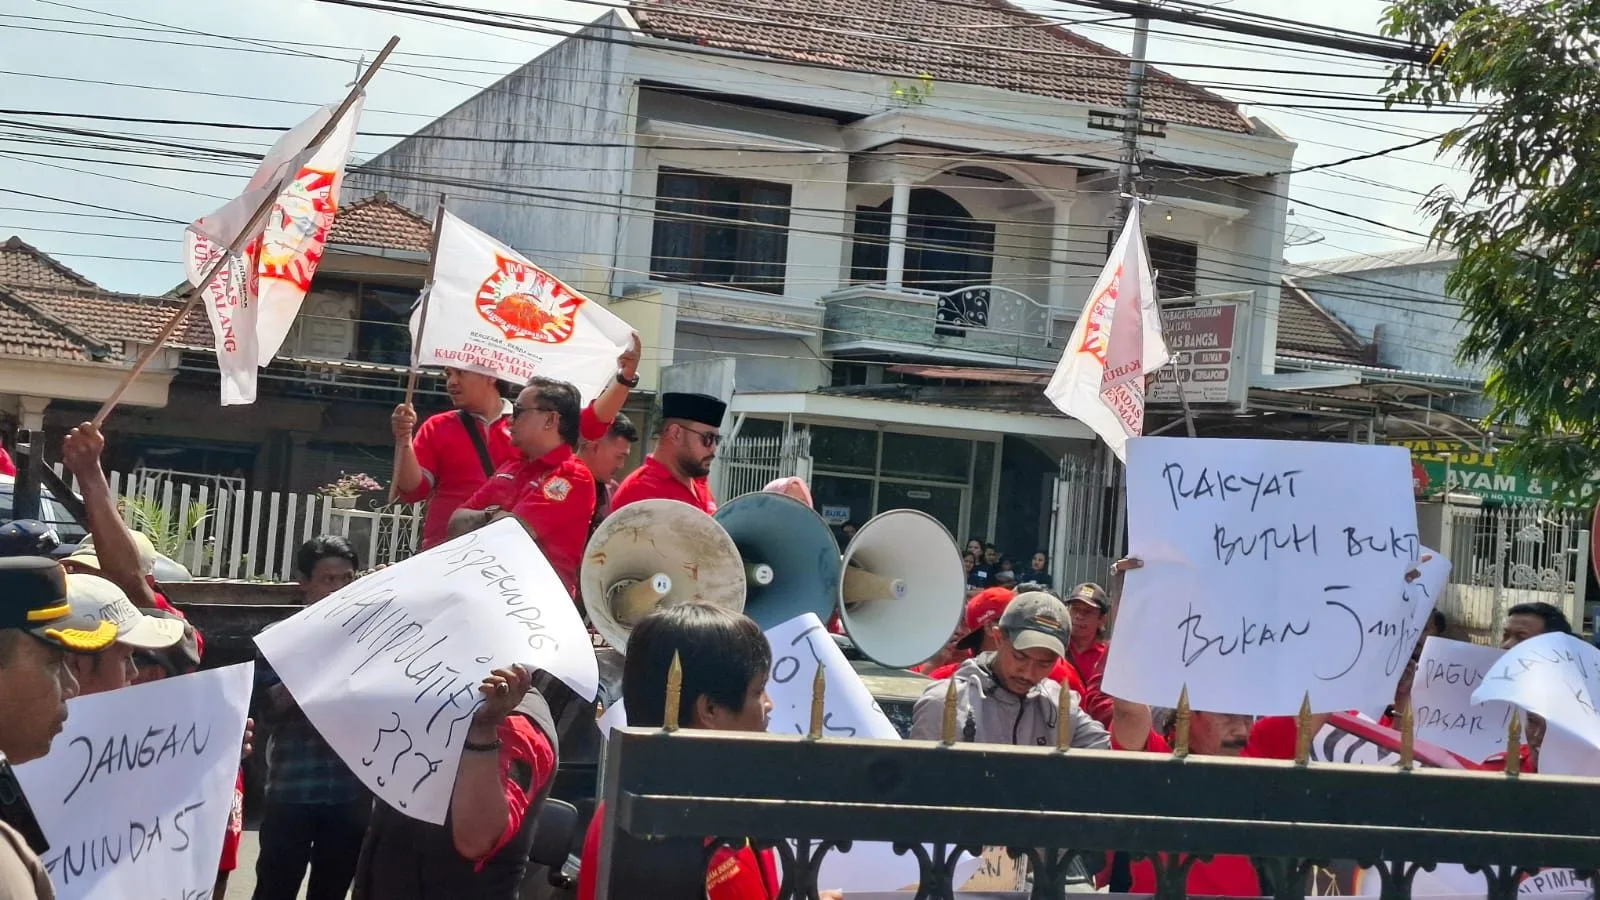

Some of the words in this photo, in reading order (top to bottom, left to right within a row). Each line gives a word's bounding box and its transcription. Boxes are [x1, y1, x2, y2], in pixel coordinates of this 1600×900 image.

[462, 342, 490, 356] DPC
[491, 348, 537, 370] MADAS
[1184, 333, 1219, 348] BANGSA
[434, 348, 506, 372] KABUPATEN
[508, 365, 535, 379] MAL
[1162, 461, 1303, 512] RAKYAT
[1443, 469, 1516, 493] AYAM
[1527, 477, 1543, 494] &
[1178, 602, 1310, 667] BUKAN
[1416, 705, 1485, 737] PASAR
[64, 722, 212, 805] JANGAN
